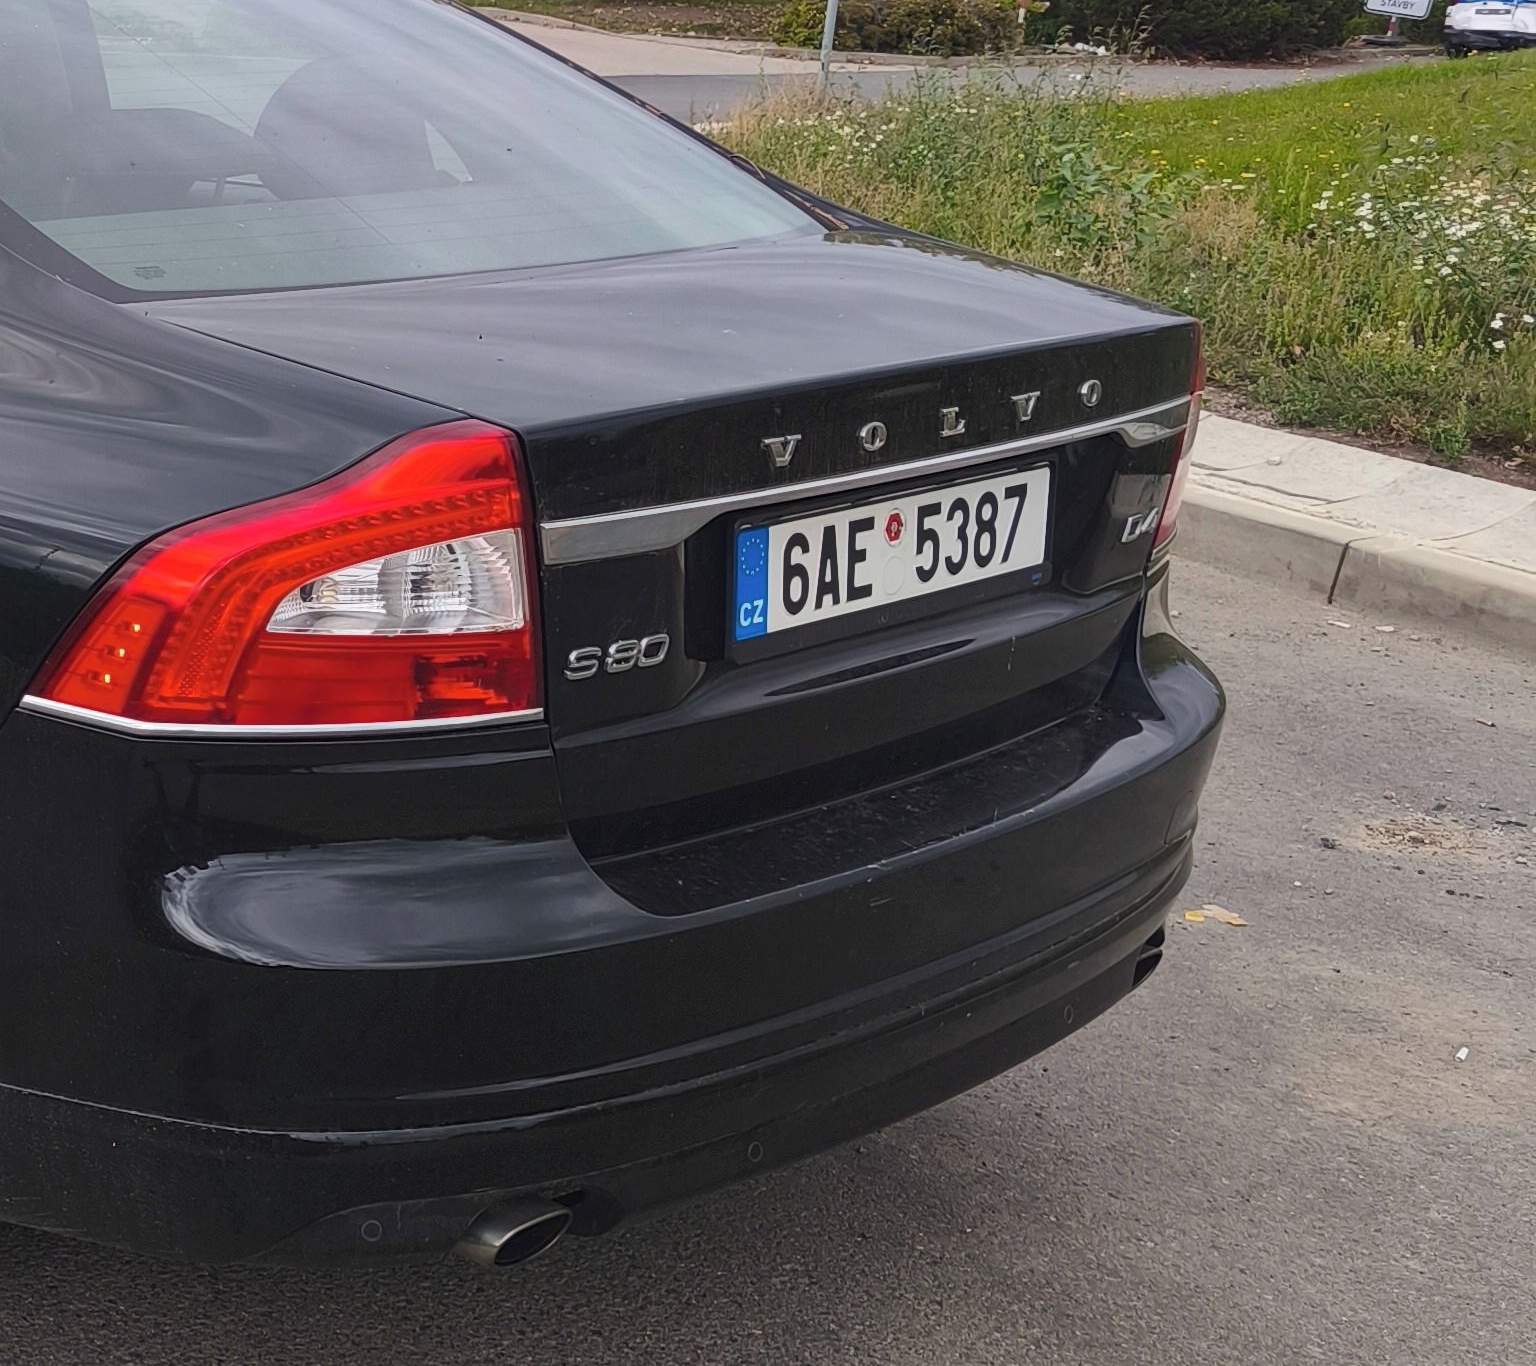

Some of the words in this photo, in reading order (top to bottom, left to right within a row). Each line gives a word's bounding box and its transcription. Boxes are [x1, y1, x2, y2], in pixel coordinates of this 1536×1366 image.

[761, 378, 1103, 468] VOLVO
[782, 515, 875, 616] 6AE
[915, 482, 1028, 584] 5387
[738, 598, 765, 628] CZ
[562, 633, 670, 681] S80
